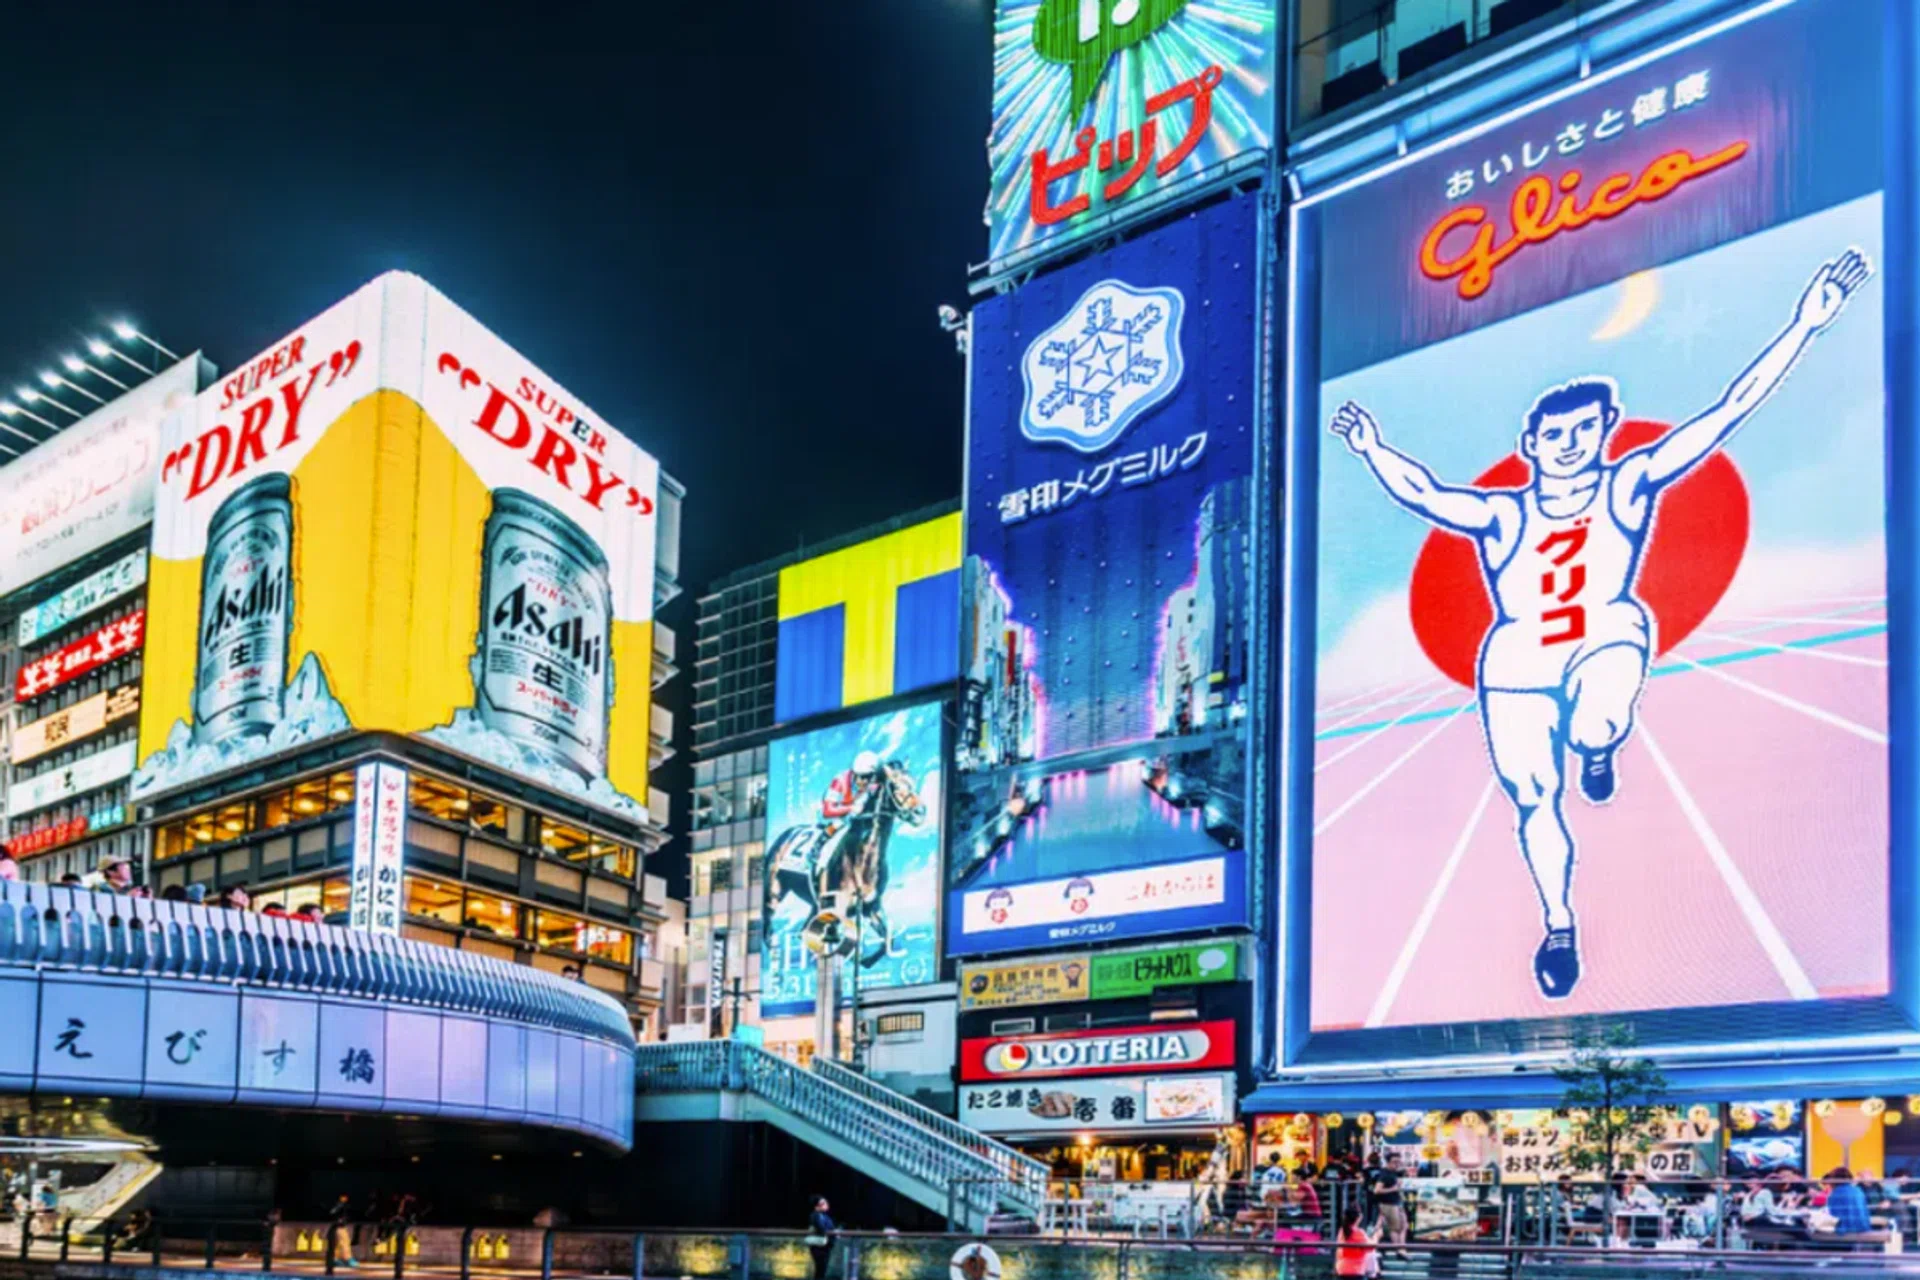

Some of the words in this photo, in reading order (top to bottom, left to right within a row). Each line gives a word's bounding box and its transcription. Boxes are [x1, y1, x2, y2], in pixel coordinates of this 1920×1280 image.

[1030, 64, 1223, 226] ピップ
[1446, 69, 1710, 199] おいしさと健康
[1420, 141, 1749, 299] Glico
[220, 336, 306, 410] SUPER
[516, 376, 607, 457] SUPER
[998, 432, 1208, 522] 雪印メグミルク
[205, 563, 283, 648] Asahi
[1535, 517, 1592, 646] グリコ
[229, 642, 252, 670] 生
[493, 582, 600, 676] Asahi
[532, 662, 564, 693] 生
[1037, 1035, 1187, 1065] LOTTERIA
[967, 1088, 1042, 1110] たこ焼き
